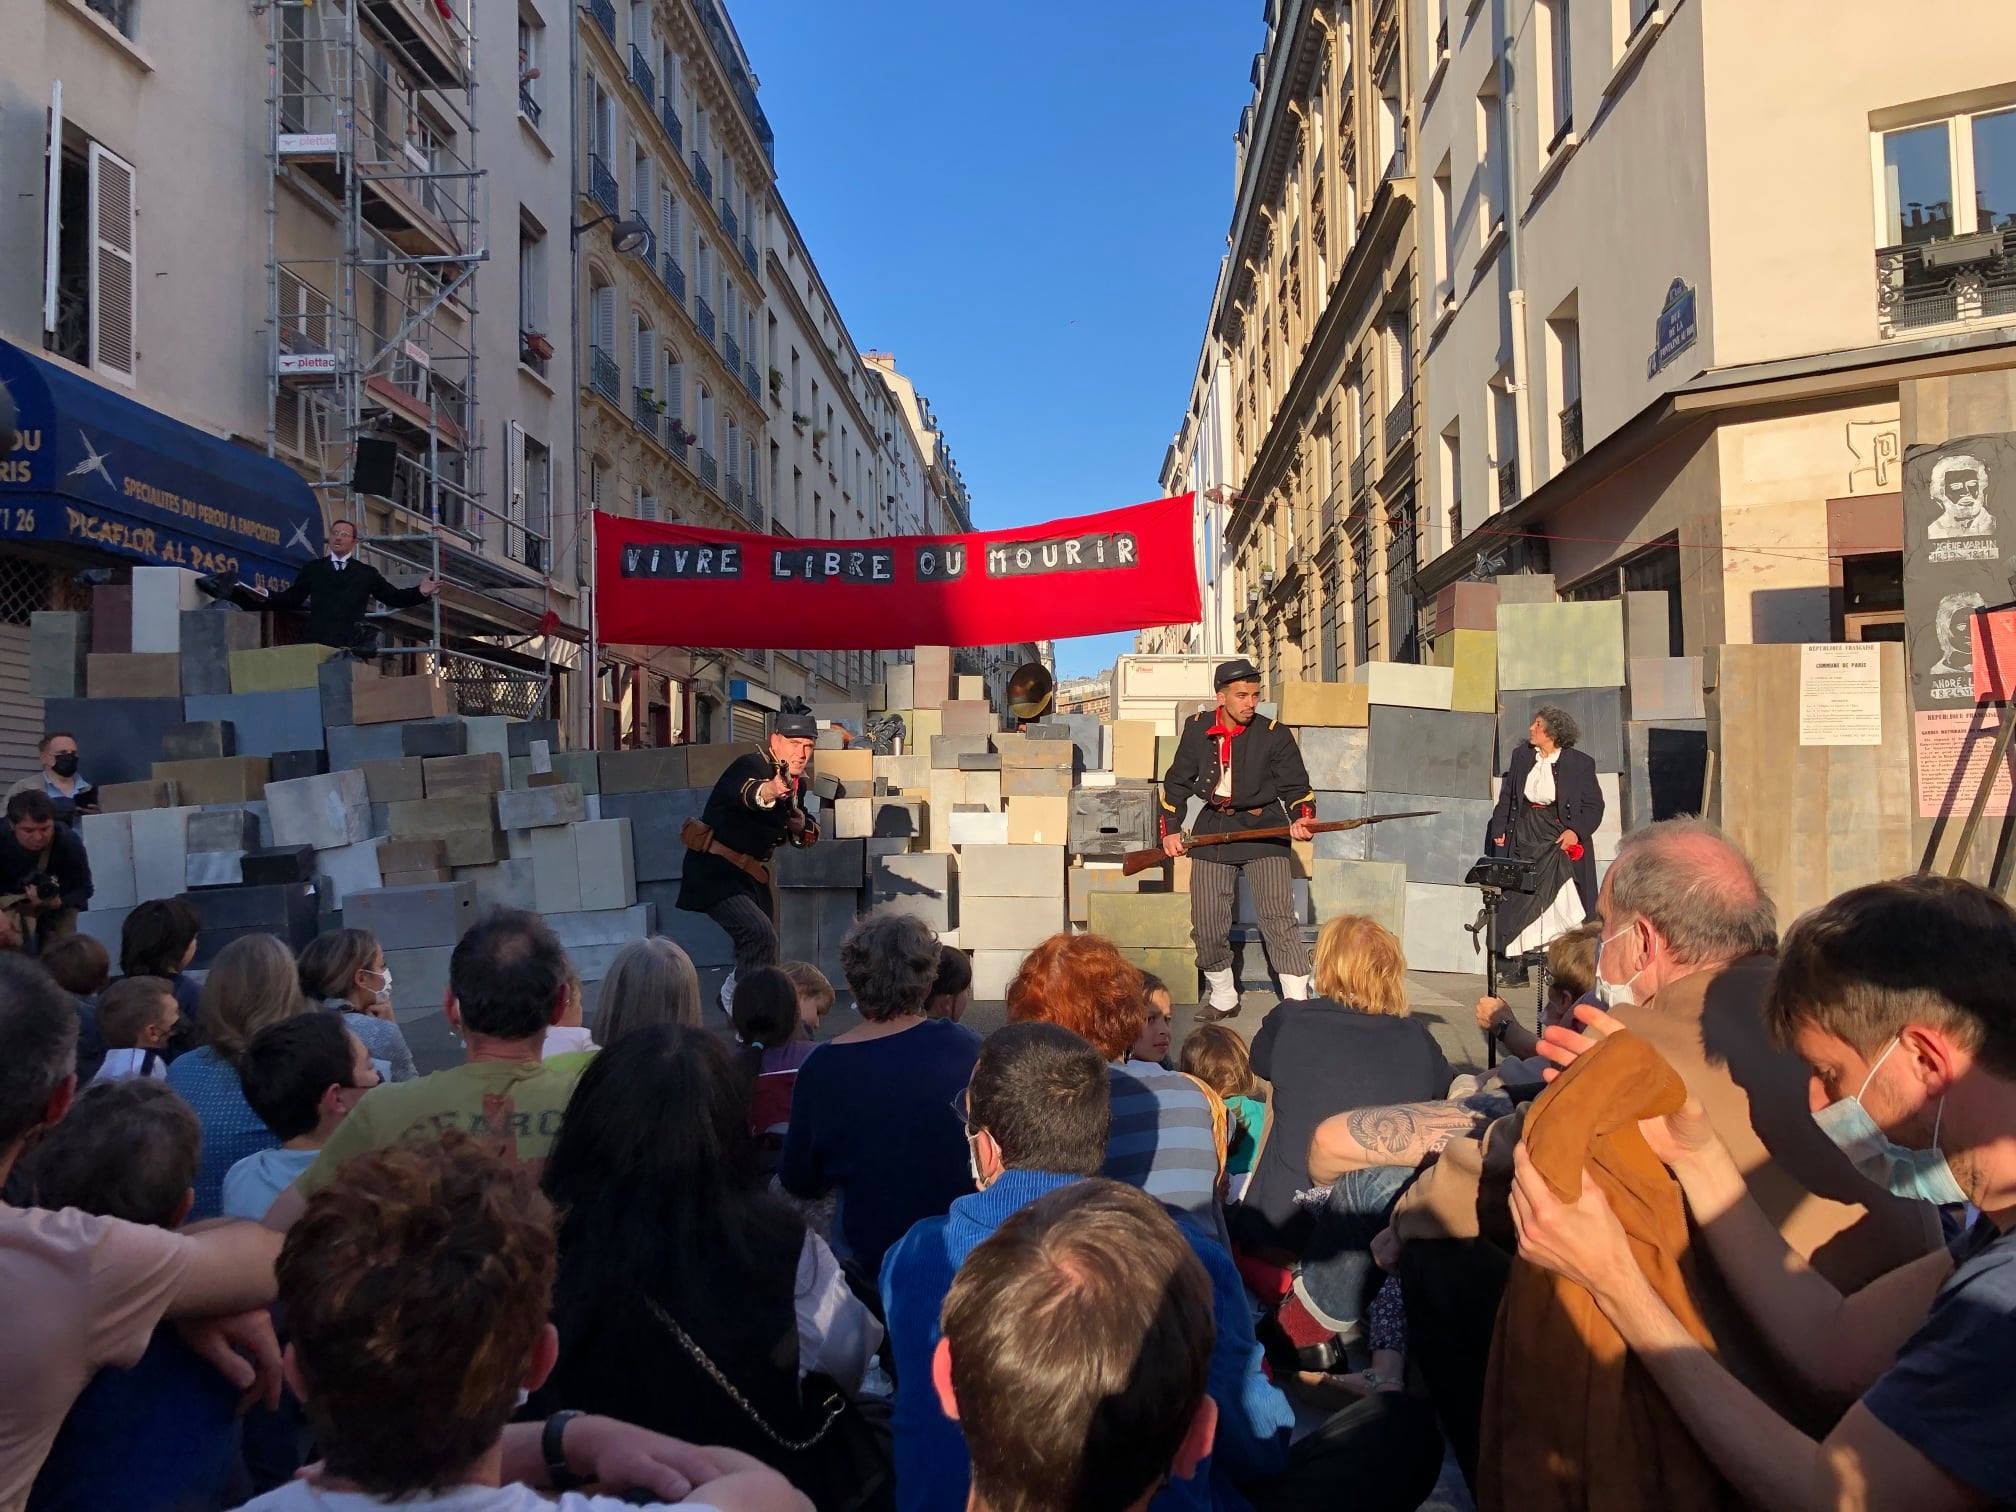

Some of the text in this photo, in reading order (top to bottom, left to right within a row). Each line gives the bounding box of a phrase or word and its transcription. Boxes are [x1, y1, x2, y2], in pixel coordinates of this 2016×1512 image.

[300, 136, 336, 147] plettac
[298, 357, 336, 369] plettac
[16, 508, 34, 531] 26
[65, 506, 239, 574] PICAFLOR AL PASO
[920, 551, 961, 576] OU
